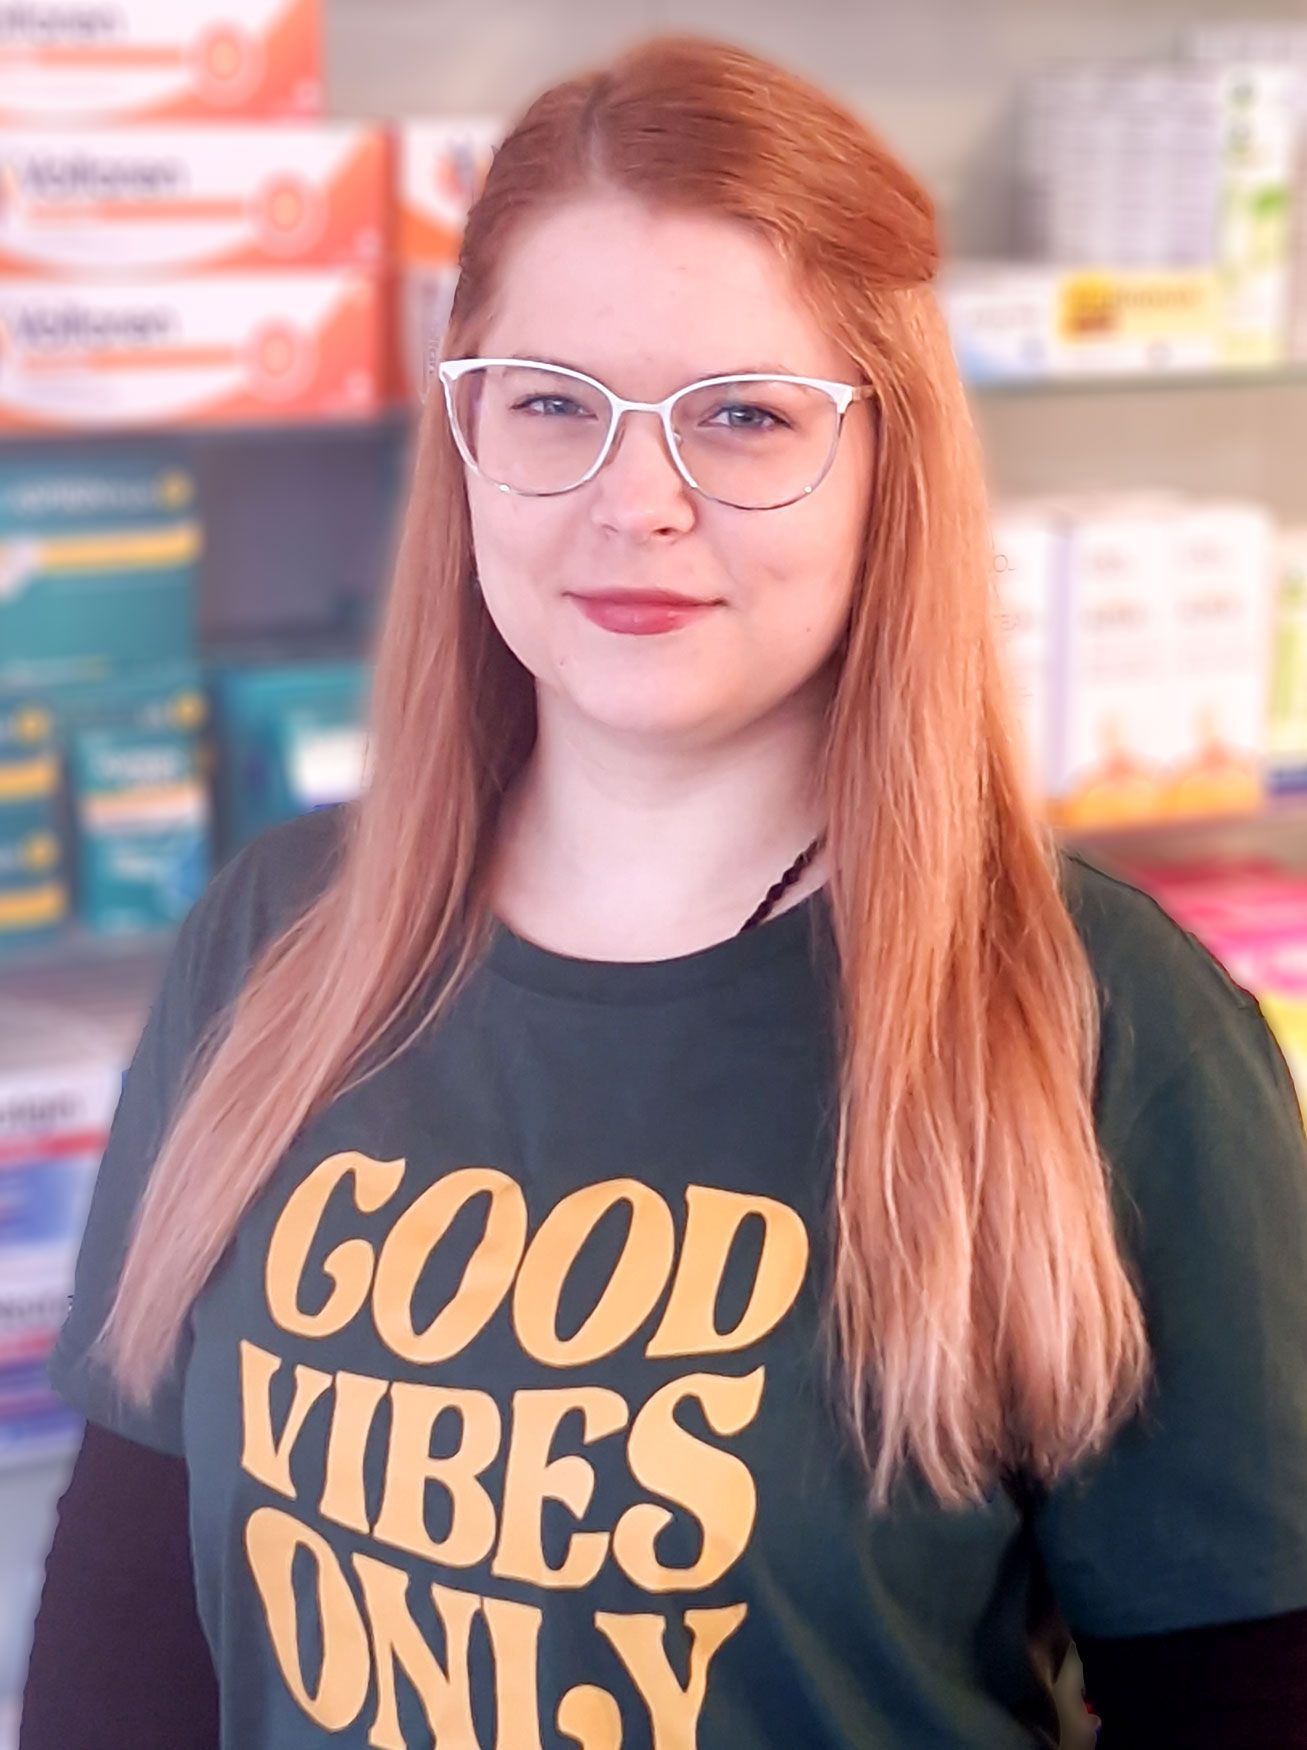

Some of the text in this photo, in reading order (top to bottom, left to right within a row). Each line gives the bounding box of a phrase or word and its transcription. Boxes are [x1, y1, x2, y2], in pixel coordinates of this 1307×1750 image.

[265, 1151, 809, 1367] GOOD
[240, 1339, 765, 1594] VIBES
[245, 1507, 748, 1750] ONLY
